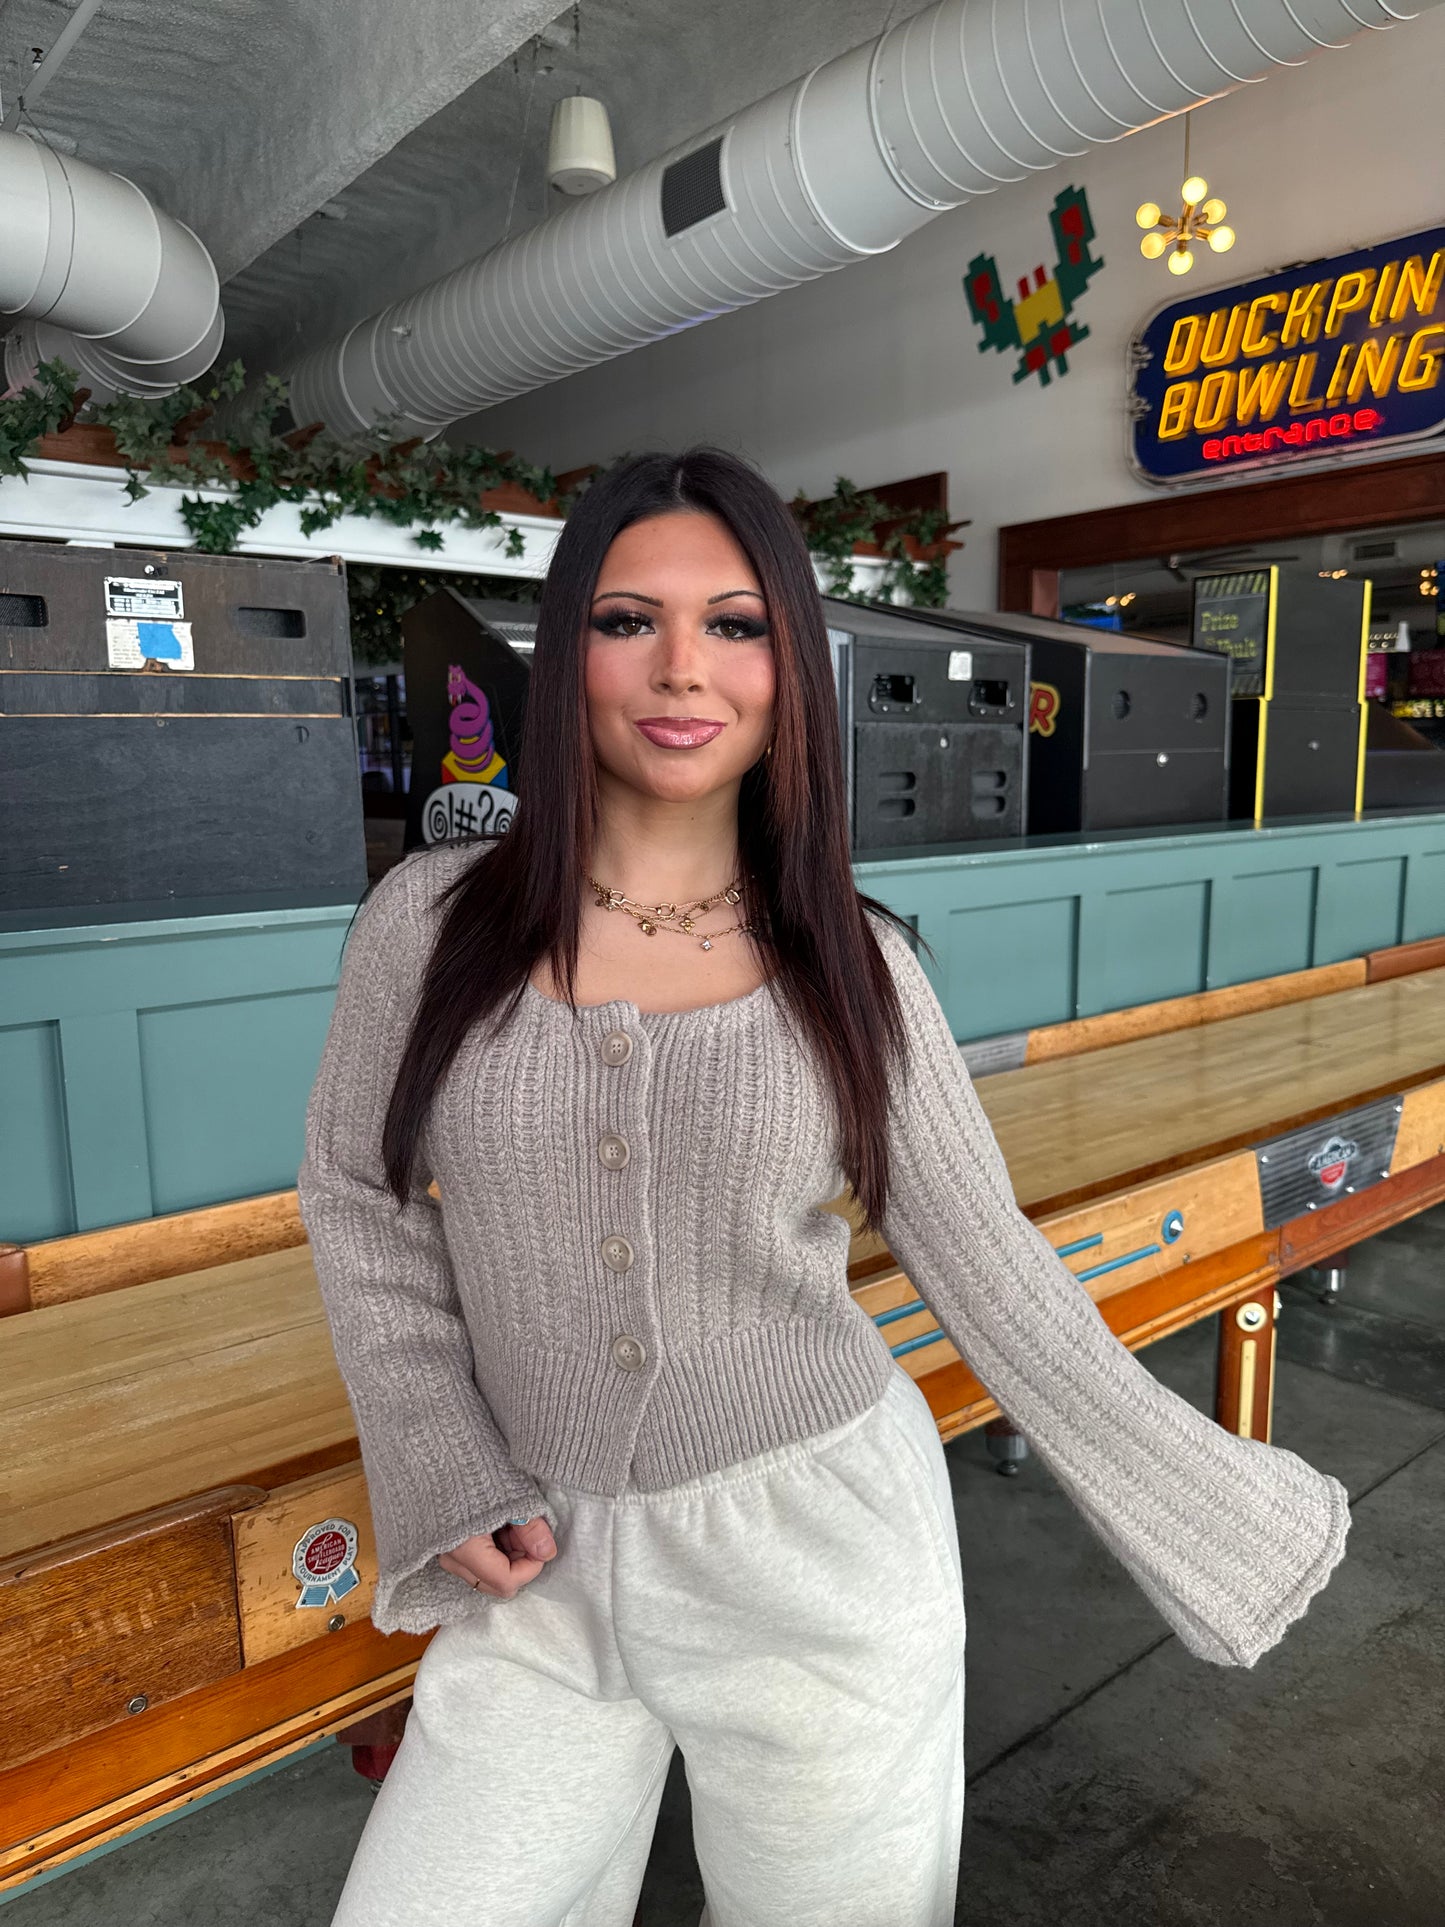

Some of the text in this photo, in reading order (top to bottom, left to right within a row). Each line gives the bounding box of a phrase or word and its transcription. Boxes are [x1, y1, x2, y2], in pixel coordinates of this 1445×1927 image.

[1163, 248, 1445, 379] DUCKPIN
[1158, 323, 1445, 442] BOWLING
[1202, 408, 1382, 460] entrance
[1201, 612, 1239, 632] Prize
[300, 1523, 352, 1554] APPROVED FOR
[311, 1538, 342, 1554] AMERICAN
[298, 1563, 342, 1582] TOURNAMENT
[343, 1546, 354, 1566] PLAY
